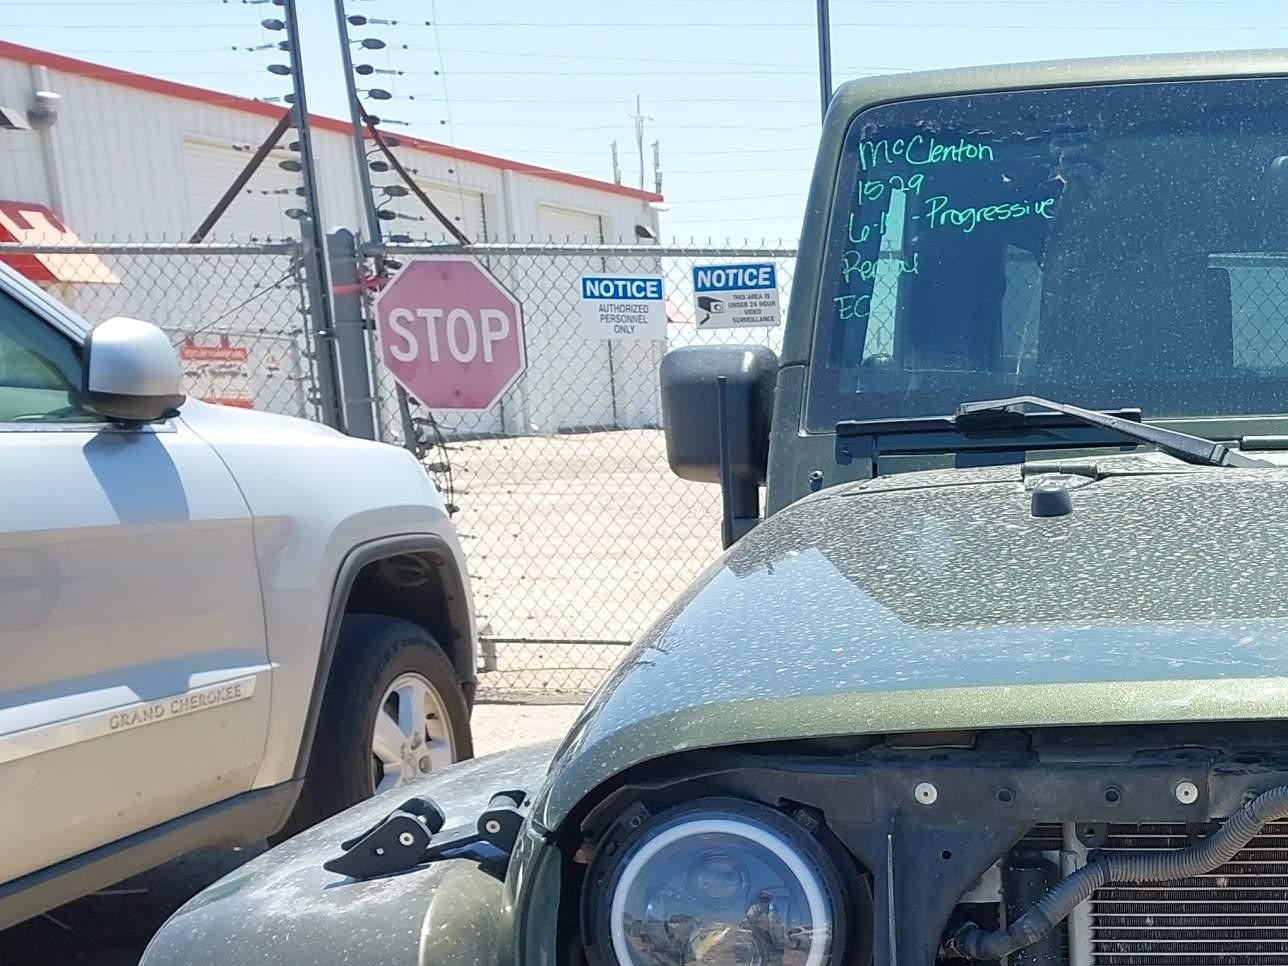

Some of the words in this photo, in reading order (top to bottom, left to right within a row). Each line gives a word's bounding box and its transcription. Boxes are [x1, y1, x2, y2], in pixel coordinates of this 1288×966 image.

[858, 134, 995, 170] McClenton
[857, 173, 925, 205] 1529
[926, 195, 1056, 233] Progressive
[585, 279, 660, 298] NOTICE
[696, 266, 772, 289] NOTICE
[598, 303, 649, 314] AUTHORIZED
[599, 313, 649, 324] PERSONNEL
[732, 315, 775, 323] SURVEILLANCE
[388, 307, 511, 364] STOP
[613, 324, 635, 335] ONLY
[109, 704, 165, 730] GRAND
[170, 684, 243, 714] CHEROKEE
